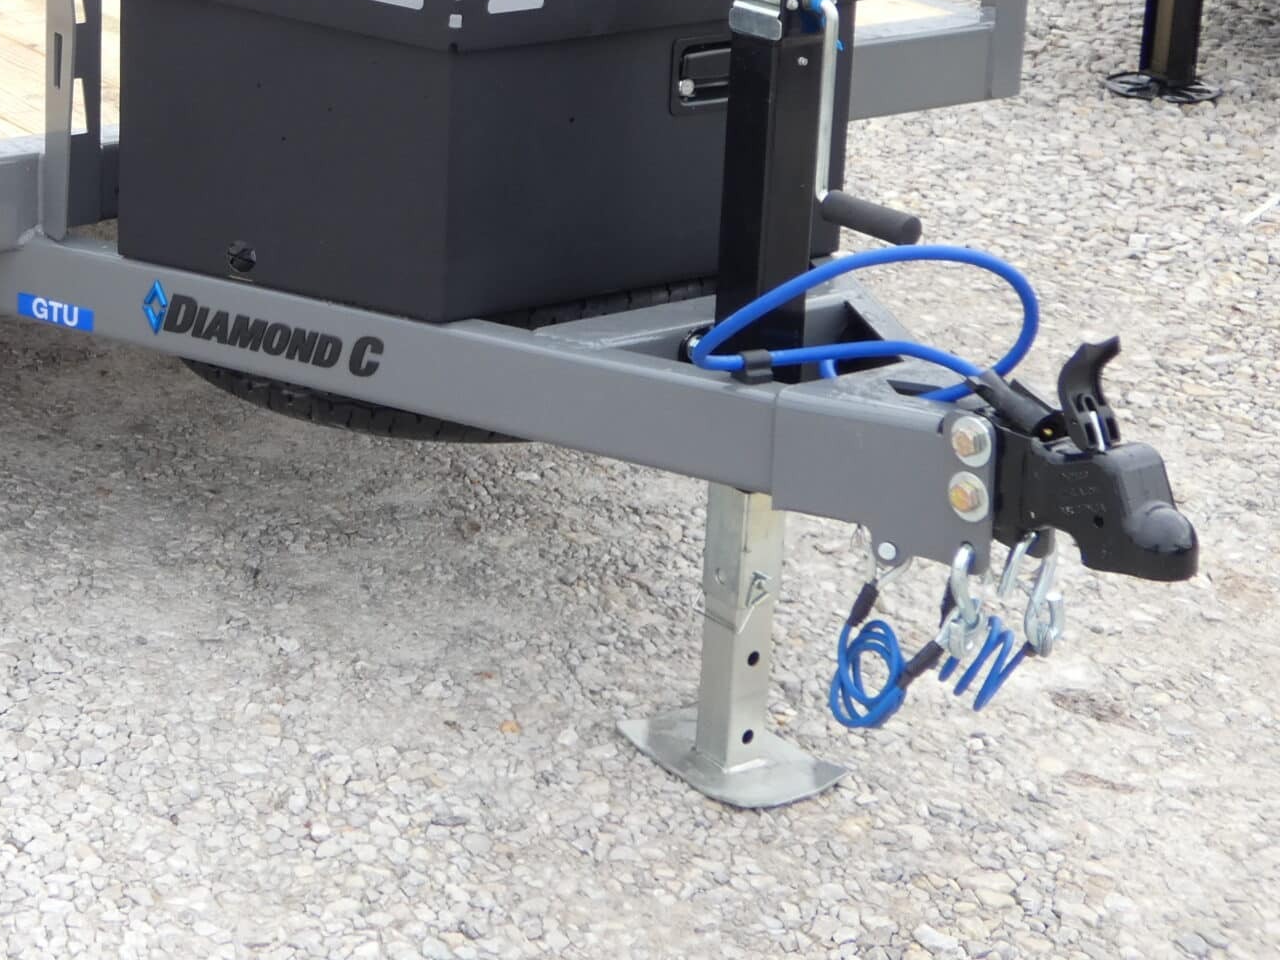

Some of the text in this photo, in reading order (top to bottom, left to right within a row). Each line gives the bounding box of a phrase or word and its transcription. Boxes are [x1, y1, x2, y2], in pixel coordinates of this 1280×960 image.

[31, 297, 79, 327] GTU
[163, 293, 385, 378] DIAMOND C
